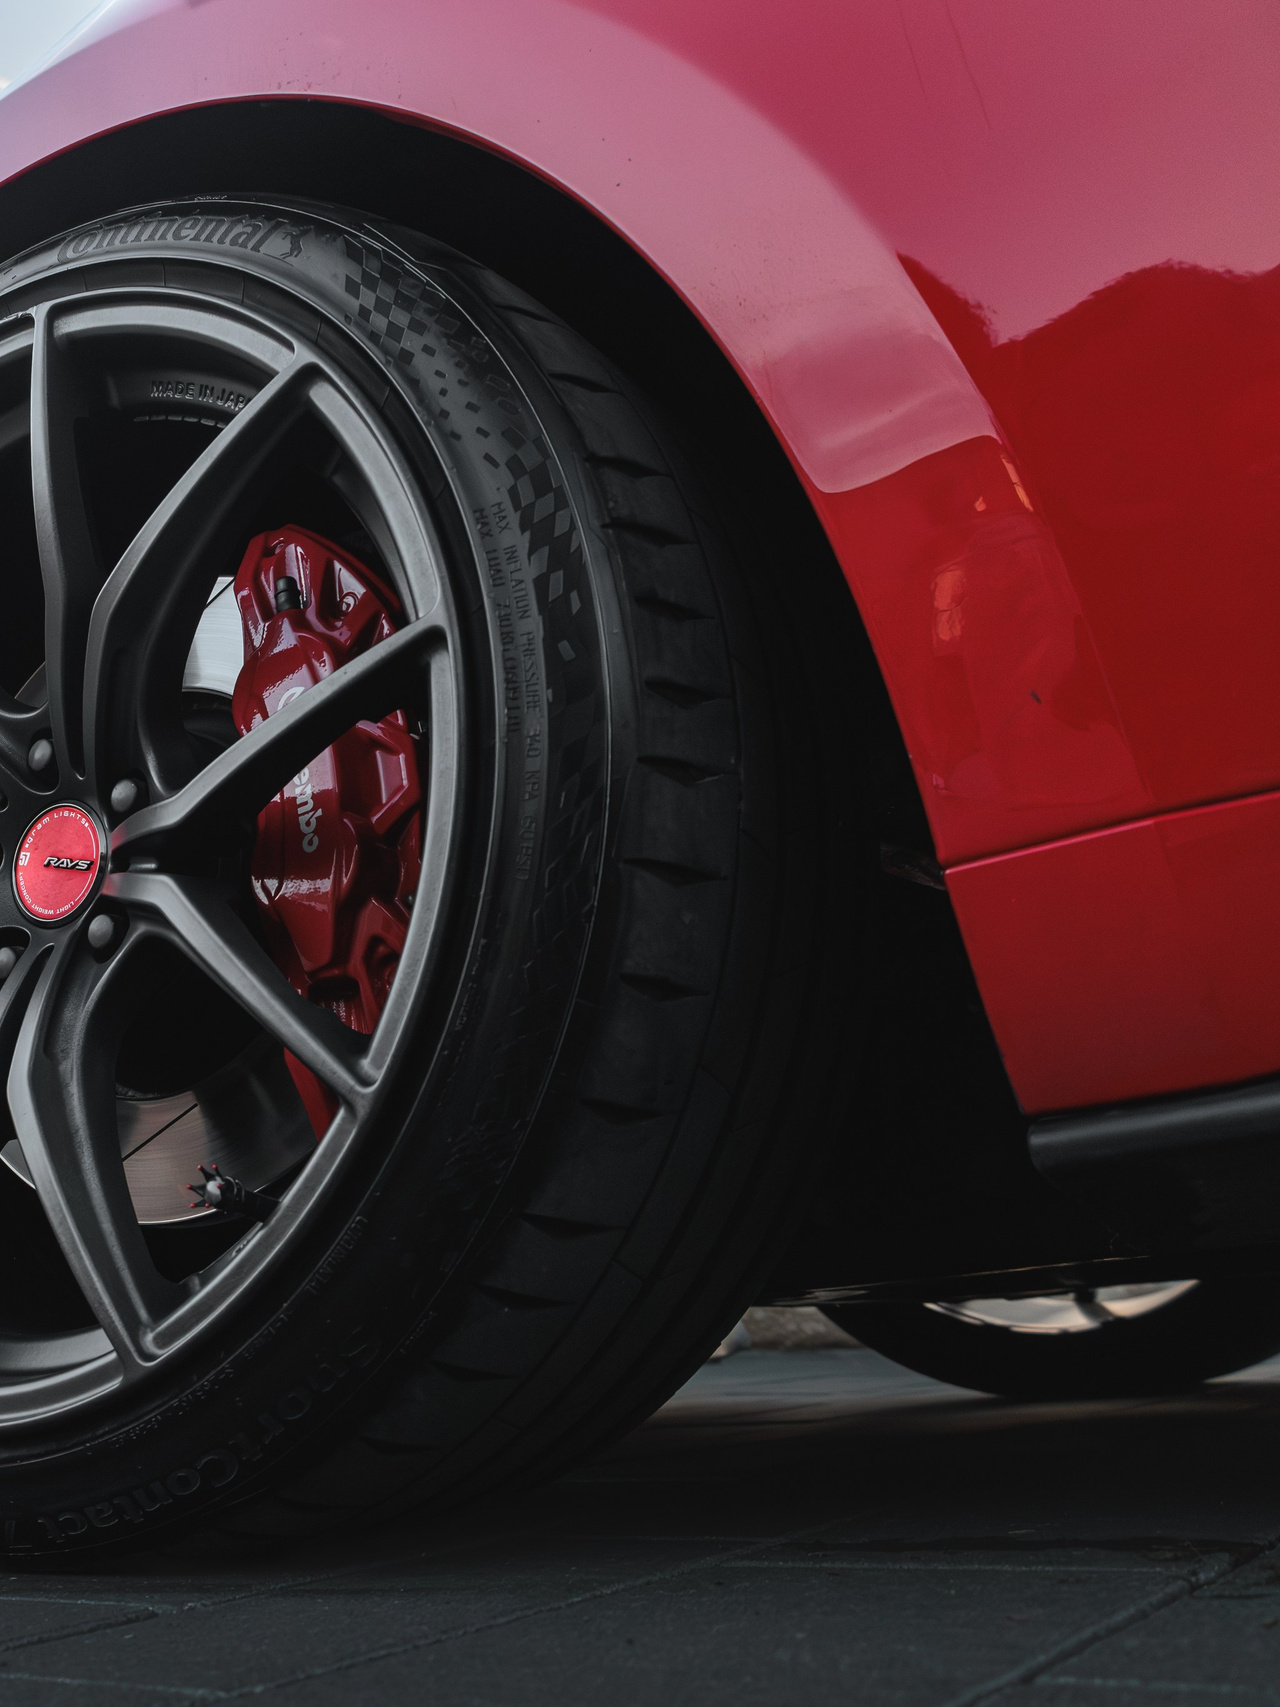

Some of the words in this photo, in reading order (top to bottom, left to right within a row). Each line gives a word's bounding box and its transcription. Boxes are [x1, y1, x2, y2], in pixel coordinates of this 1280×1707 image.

[56, 210, 288, 264] Continental
[150, 381, 196, 400] MADE
[199, 384, 215, 403] IN
[217, 388, 252, 411] JAP
[473, 508, 494, 539] MAX
[491, 501, 512, 534] MAX
[54, 811, 87, 826] LIGHTS
[293, 766, 323, 853] embo
[44, 856, 94, 871] RAYS
[31, 903, 55, 915] WEIGHT
[56, 901, 75, 914] LIGHT
[37, 1325, 382, 1542] SportContact
